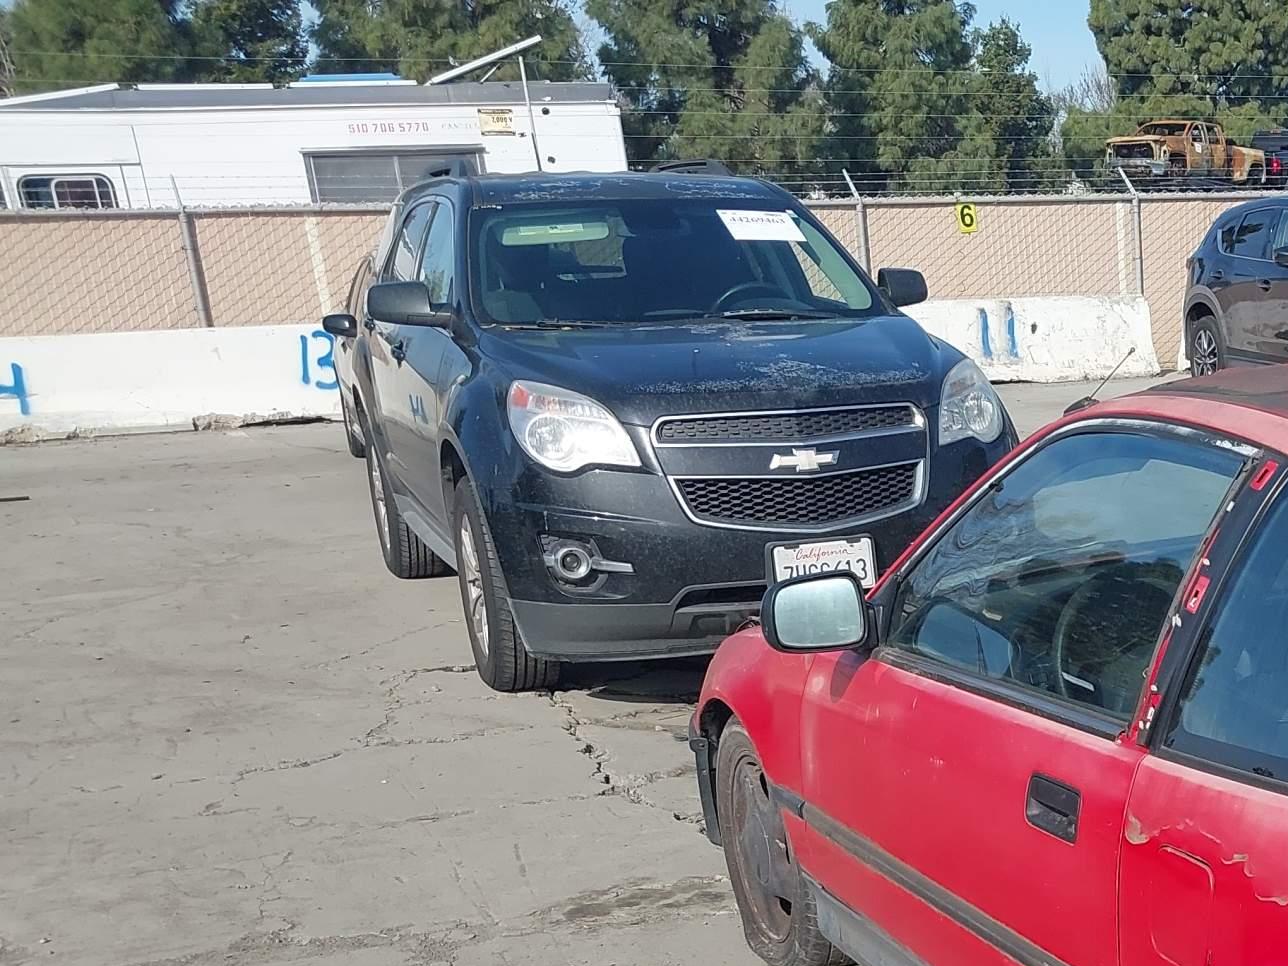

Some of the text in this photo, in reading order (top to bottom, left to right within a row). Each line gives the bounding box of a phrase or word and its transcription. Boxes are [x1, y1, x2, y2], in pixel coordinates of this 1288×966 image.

[960, 204, 974, 228] 6
[299, 330, 338, 390] 13
[795, 546, 850, 562] California
